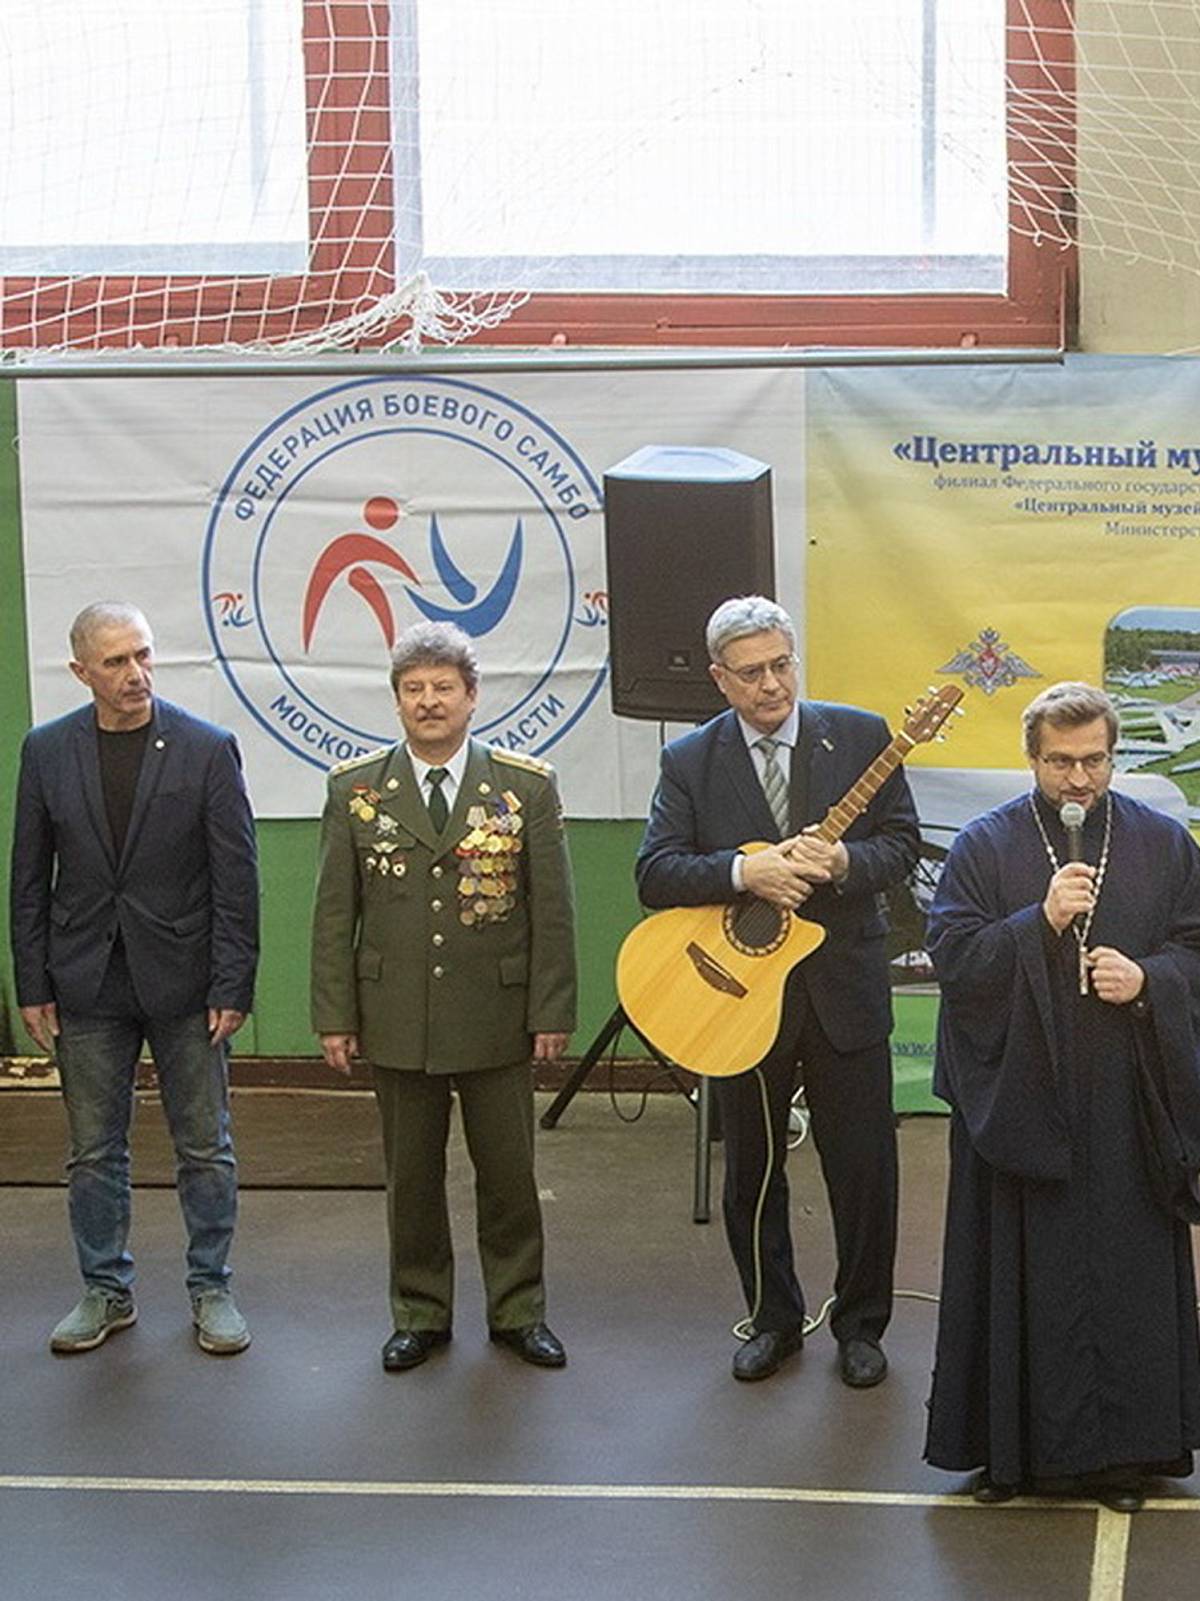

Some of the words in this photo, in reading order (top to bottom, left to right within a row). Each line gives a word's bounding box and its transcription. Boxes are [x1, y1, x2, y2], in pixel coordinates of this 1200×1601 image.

[235, 398, 374, 521] ФЕДЕРАЦИЯ
[383, 393, 514, 441] БОЕВОГО
[516, 435, 590, 520] САМБО
[893, 435, 1157, 471] «Центральный
[934, 475, 998, 490] филиал
[1002, 475, 1121, 493] Федерального
[1015, 498, 1147, 515] «Центральный
